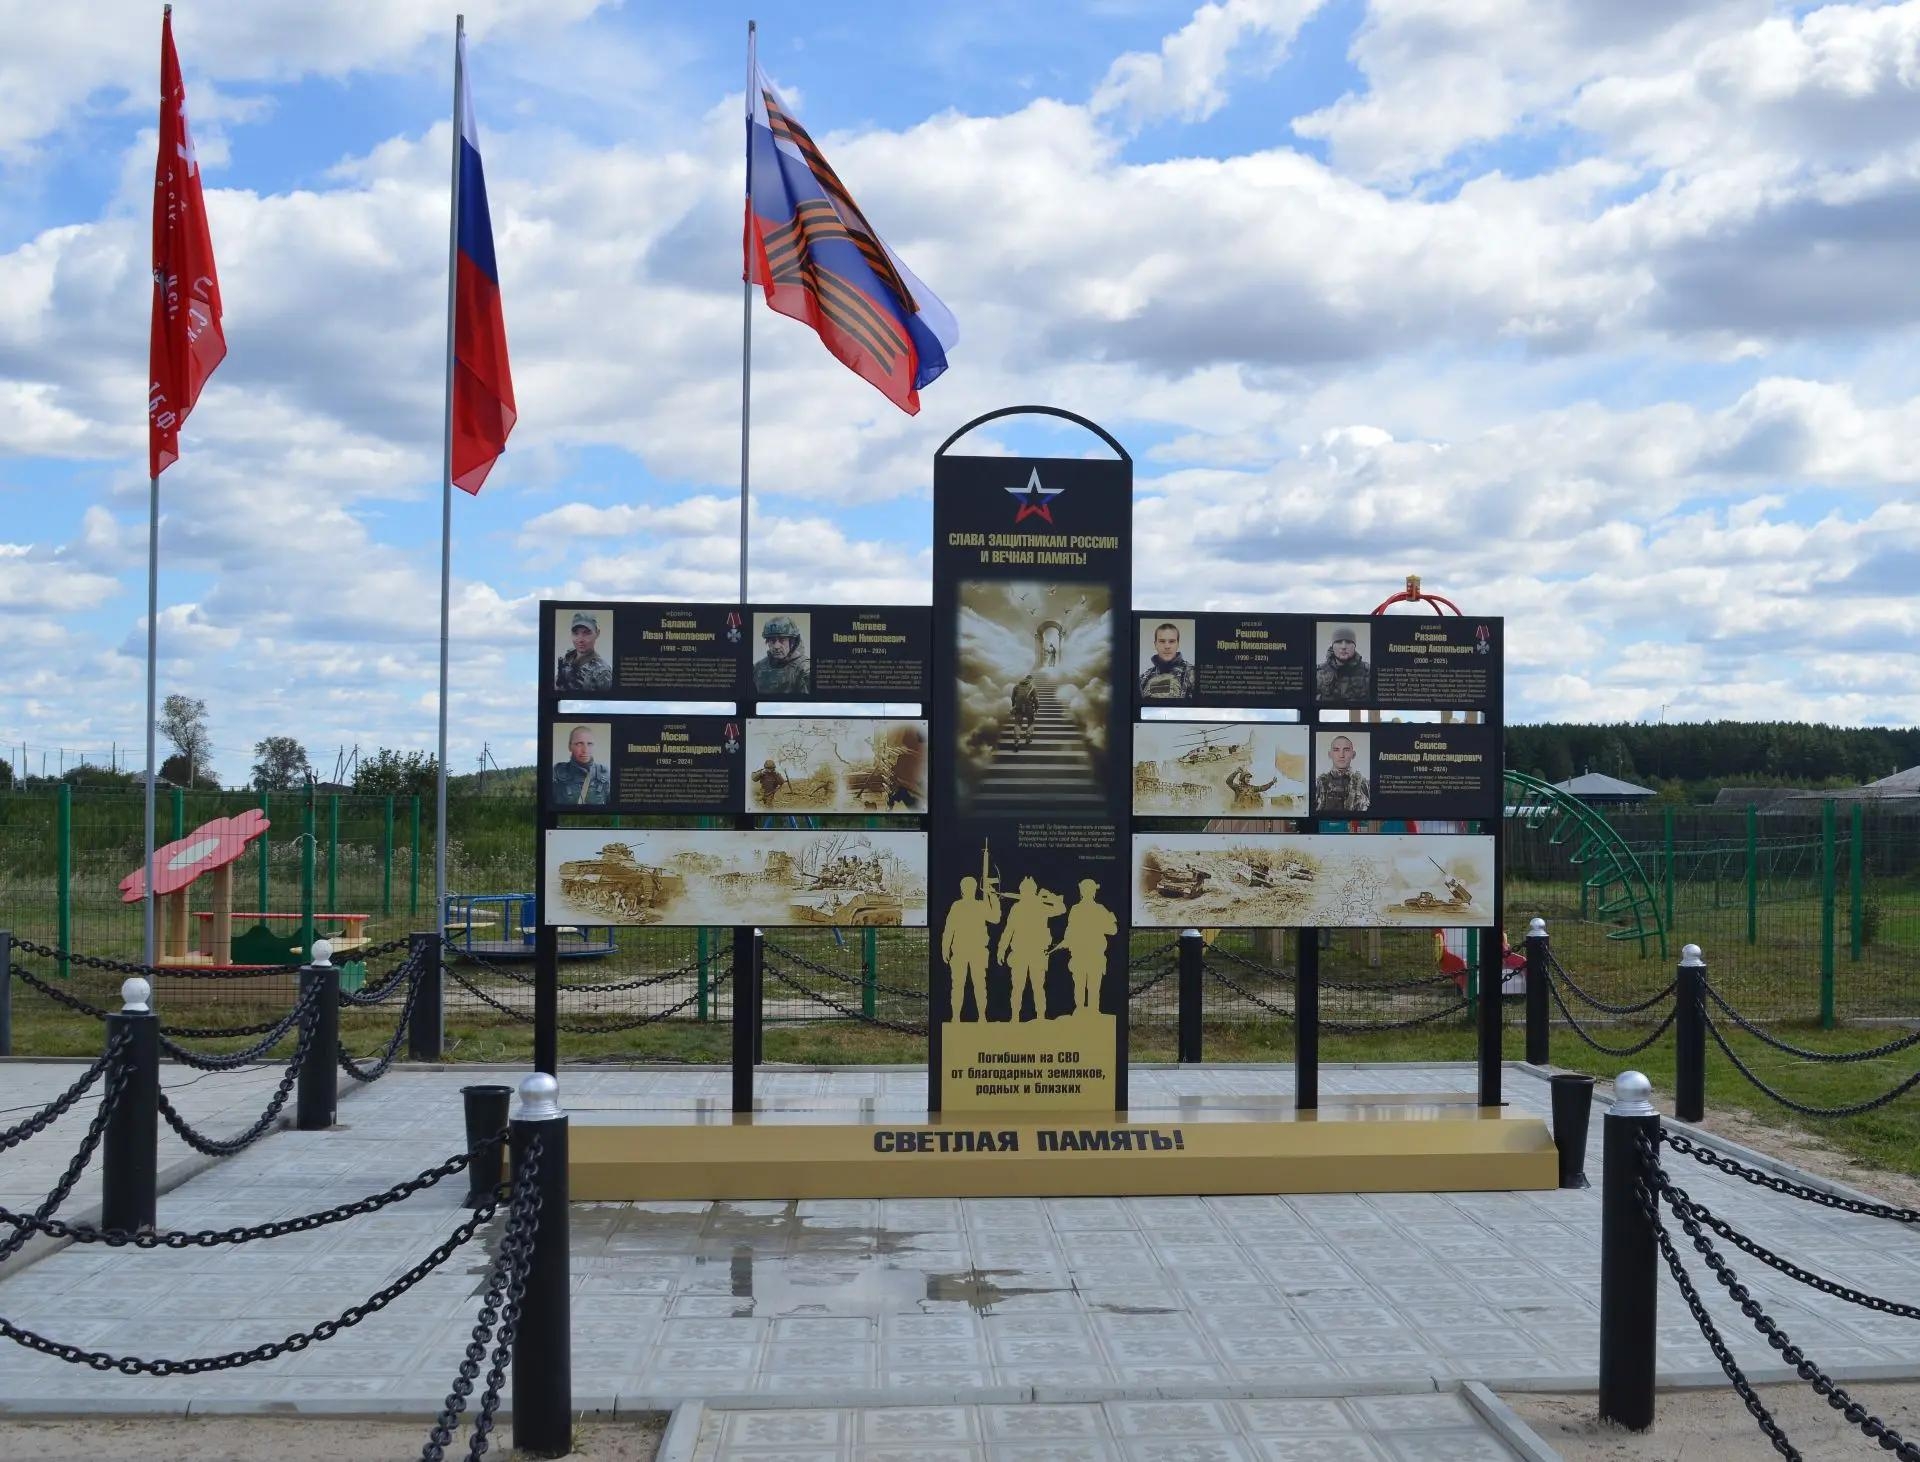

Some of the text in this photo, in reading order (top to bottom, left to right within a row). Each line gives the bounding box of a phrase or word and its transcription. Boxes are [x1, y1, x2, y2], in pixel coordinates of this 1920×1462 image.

[949, 533, 1118, 549] СЛАВА ЗАЩИТНИКАМ РОССИИ!
[981, 551, 1087, 565] И ВЕЧНАЯ ПАМЯТЬ!
[977, 1051, 1080, 1064] Погибшим на СВО
[951, 1067, 1106, 1080] от благодарных земляков,
[976, 1082, 1081, 1096] родных и близких
[872, 1129, 1185, 1153] СВЕТЛАЯ ПАМЯТЬ!
